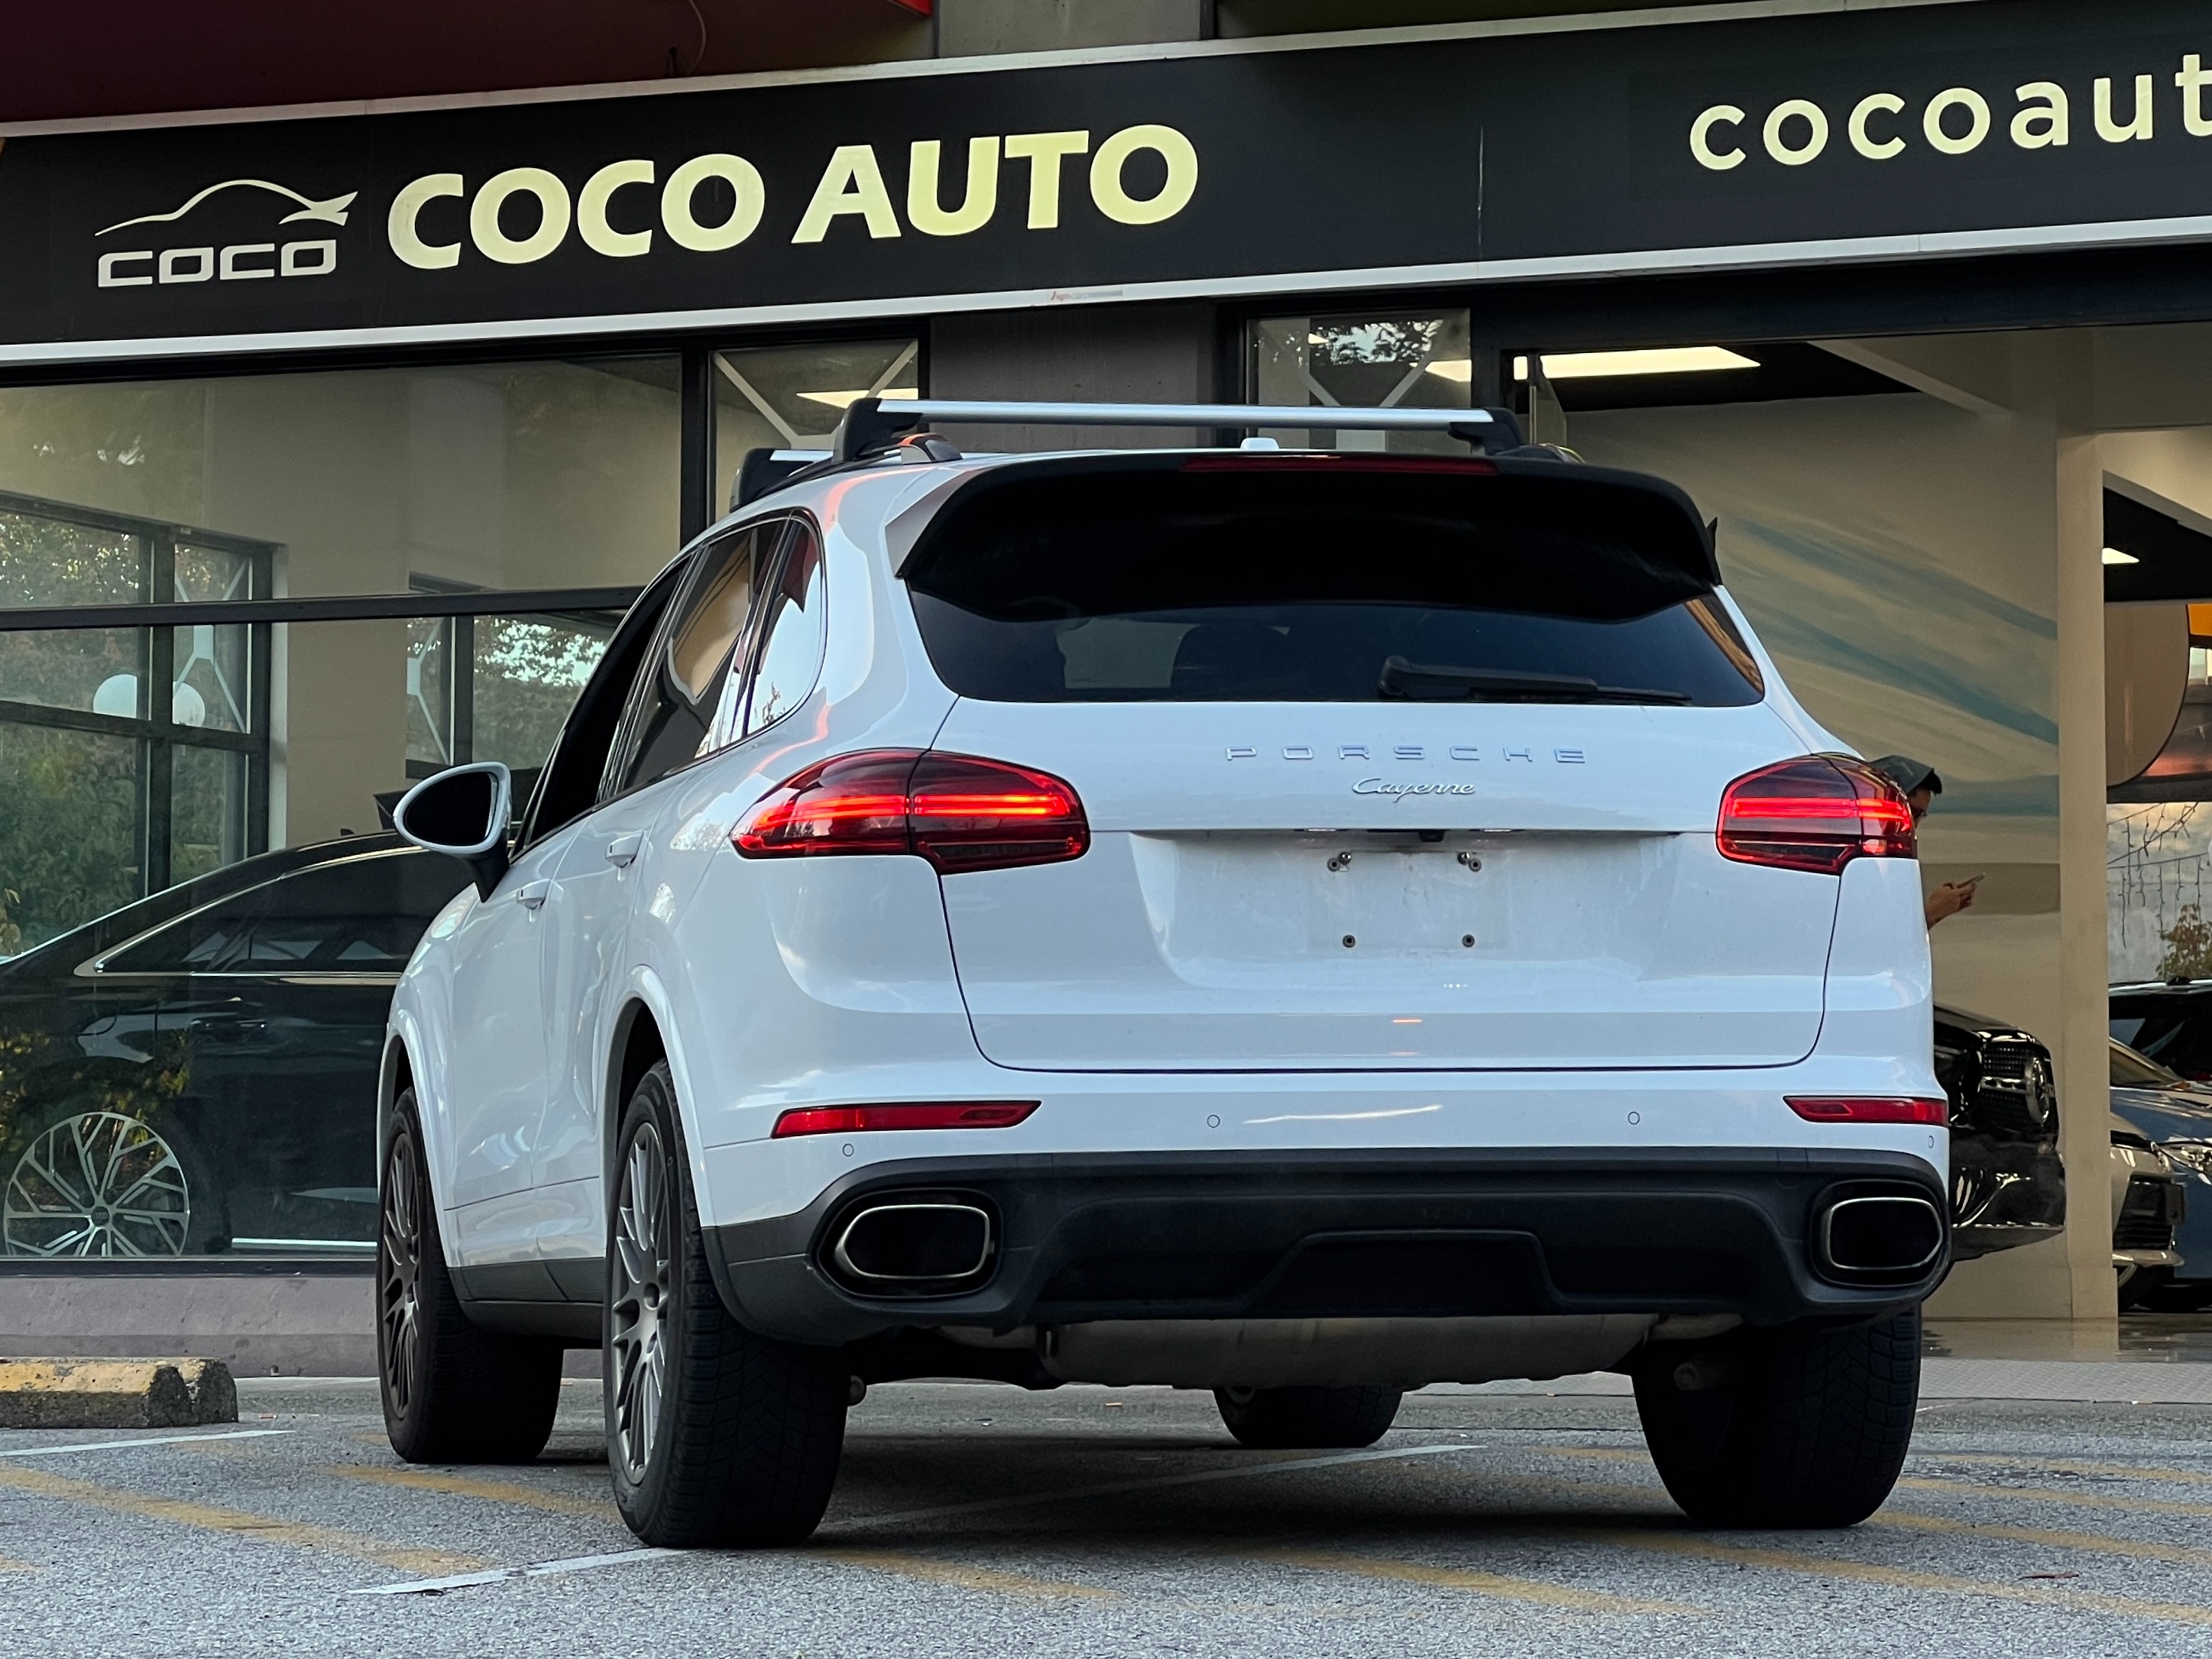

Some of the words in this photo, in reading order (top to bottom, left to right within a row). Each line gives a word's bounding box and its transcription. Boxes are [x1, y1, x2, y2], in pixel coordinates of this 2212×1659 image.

[1689, 53, 2212, 170] cocoaut
[387, 153, 766, 270] COCO
[791, 124, 1199, 244] AUTO
[98, 239, 337, 287] COCO
[1226, 744, 1585, 763] PORSCHE
[1352, 777, 1475, 804] Cayenne
